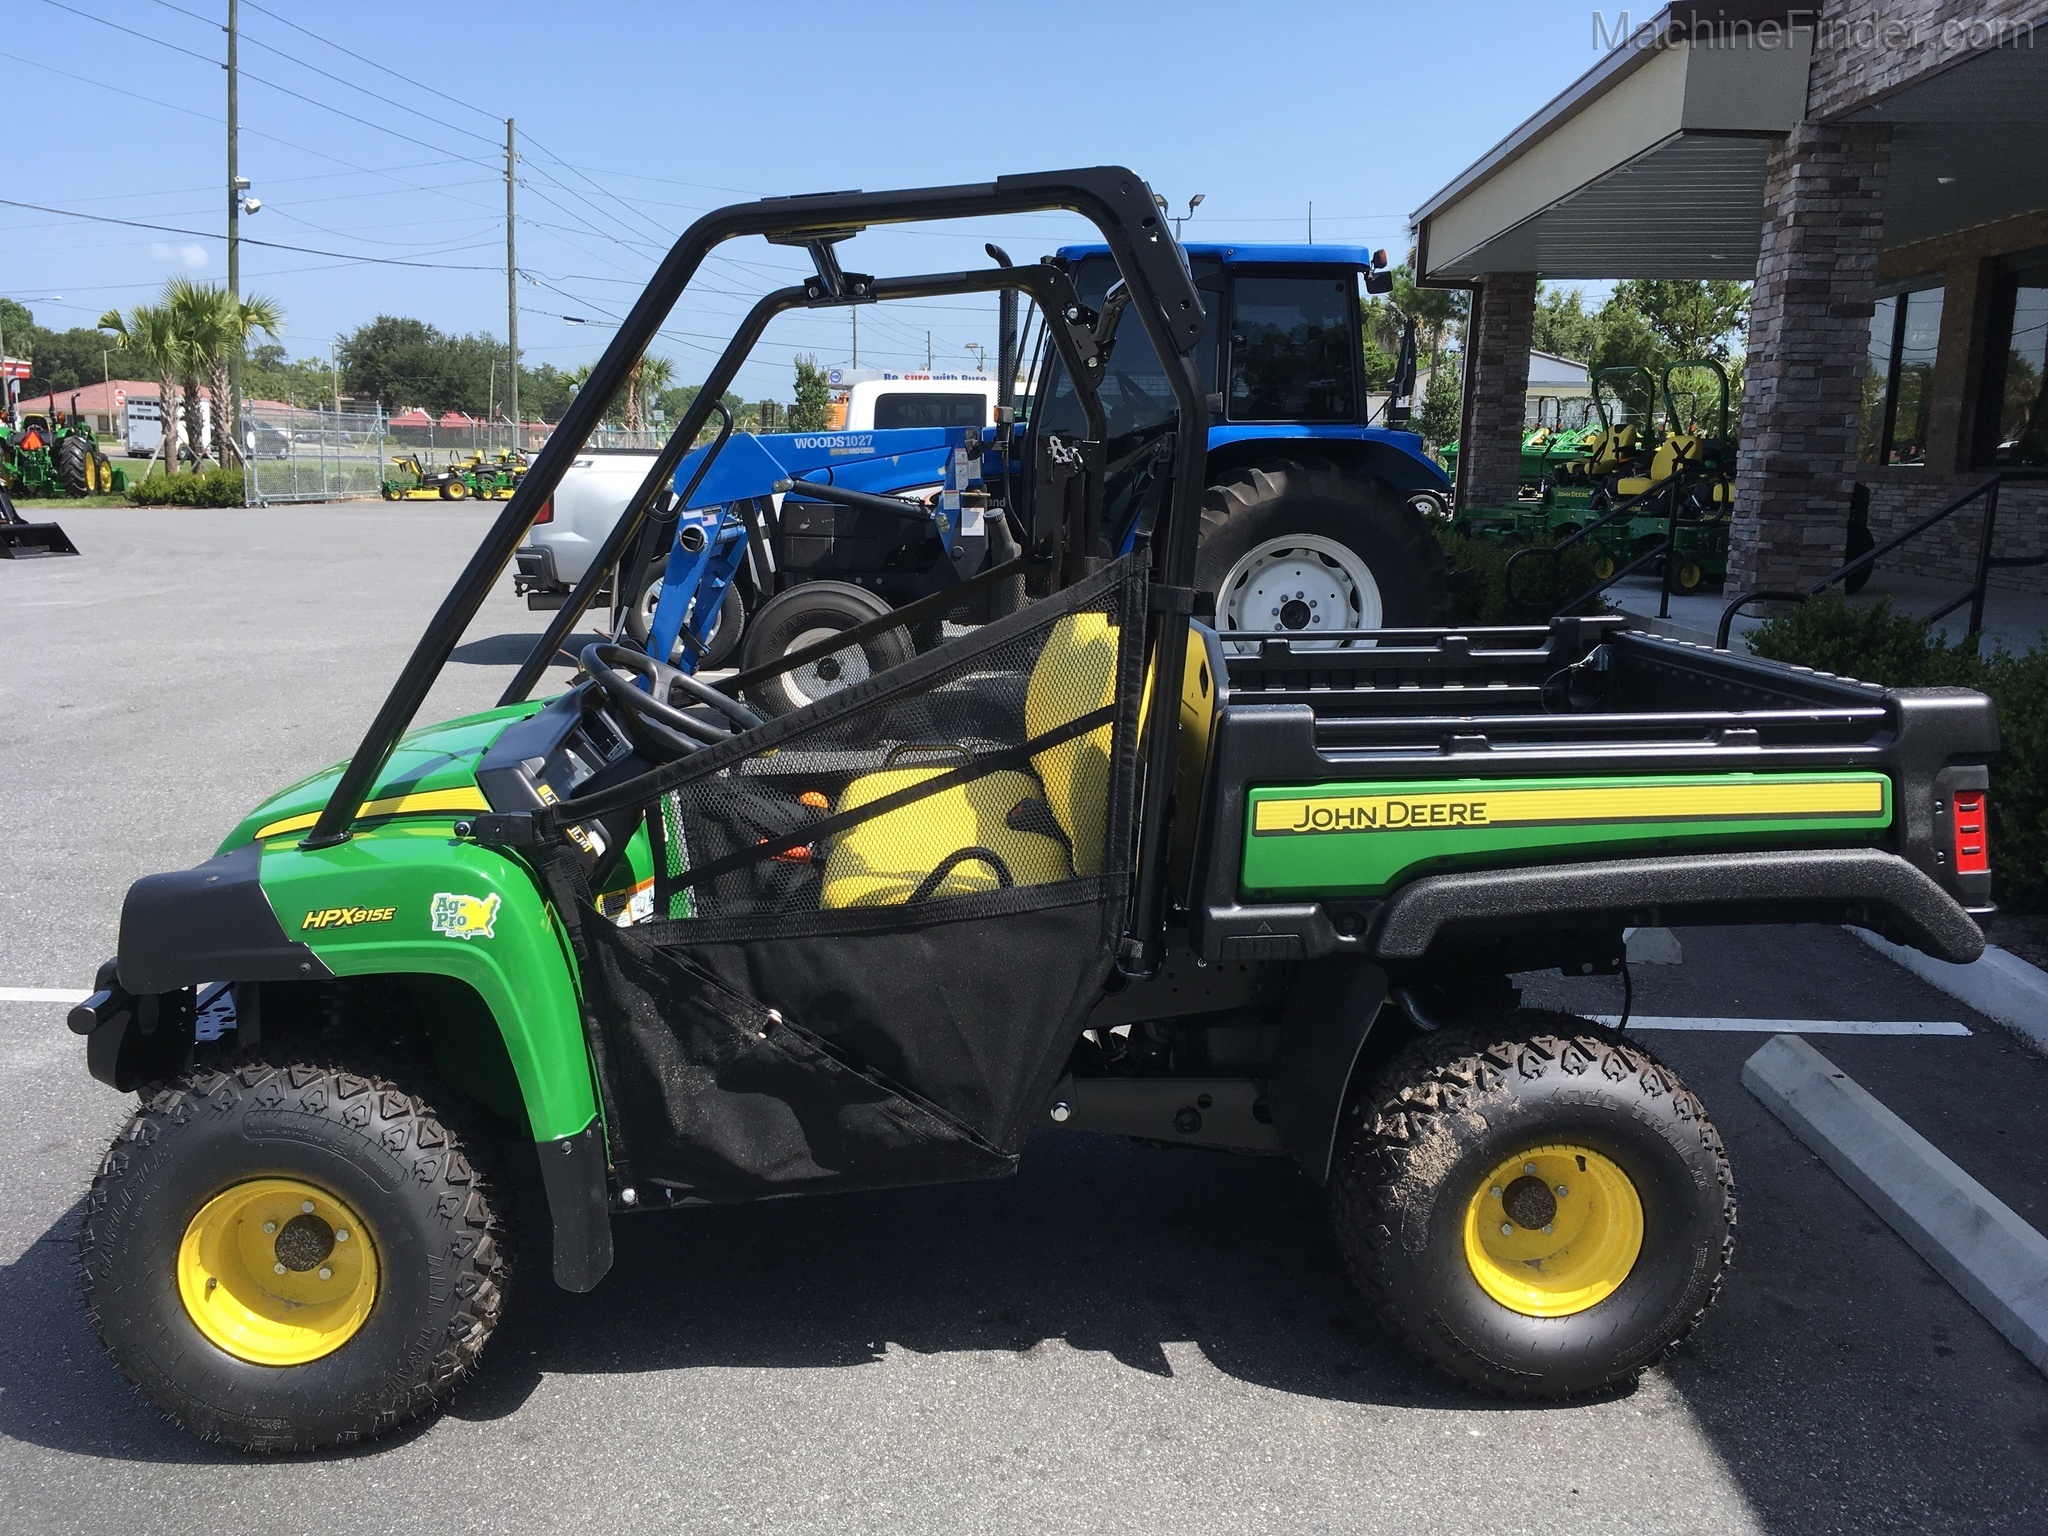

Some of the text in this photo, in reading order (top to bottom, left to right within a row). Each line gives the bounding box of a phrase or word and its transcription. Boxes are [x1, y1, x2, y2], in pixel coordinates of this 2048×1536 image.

[1293, 801, 1488, 828] JOHN DEERE
[302, 906, 396, 930] HPX815E
[435, 897, 467, 915] Ag-
[436, 912, 468, 928] Pro
[1562, 1089, 1619, 1112] ALL
[1631, 1102, 1695, 1167] TRAIL
